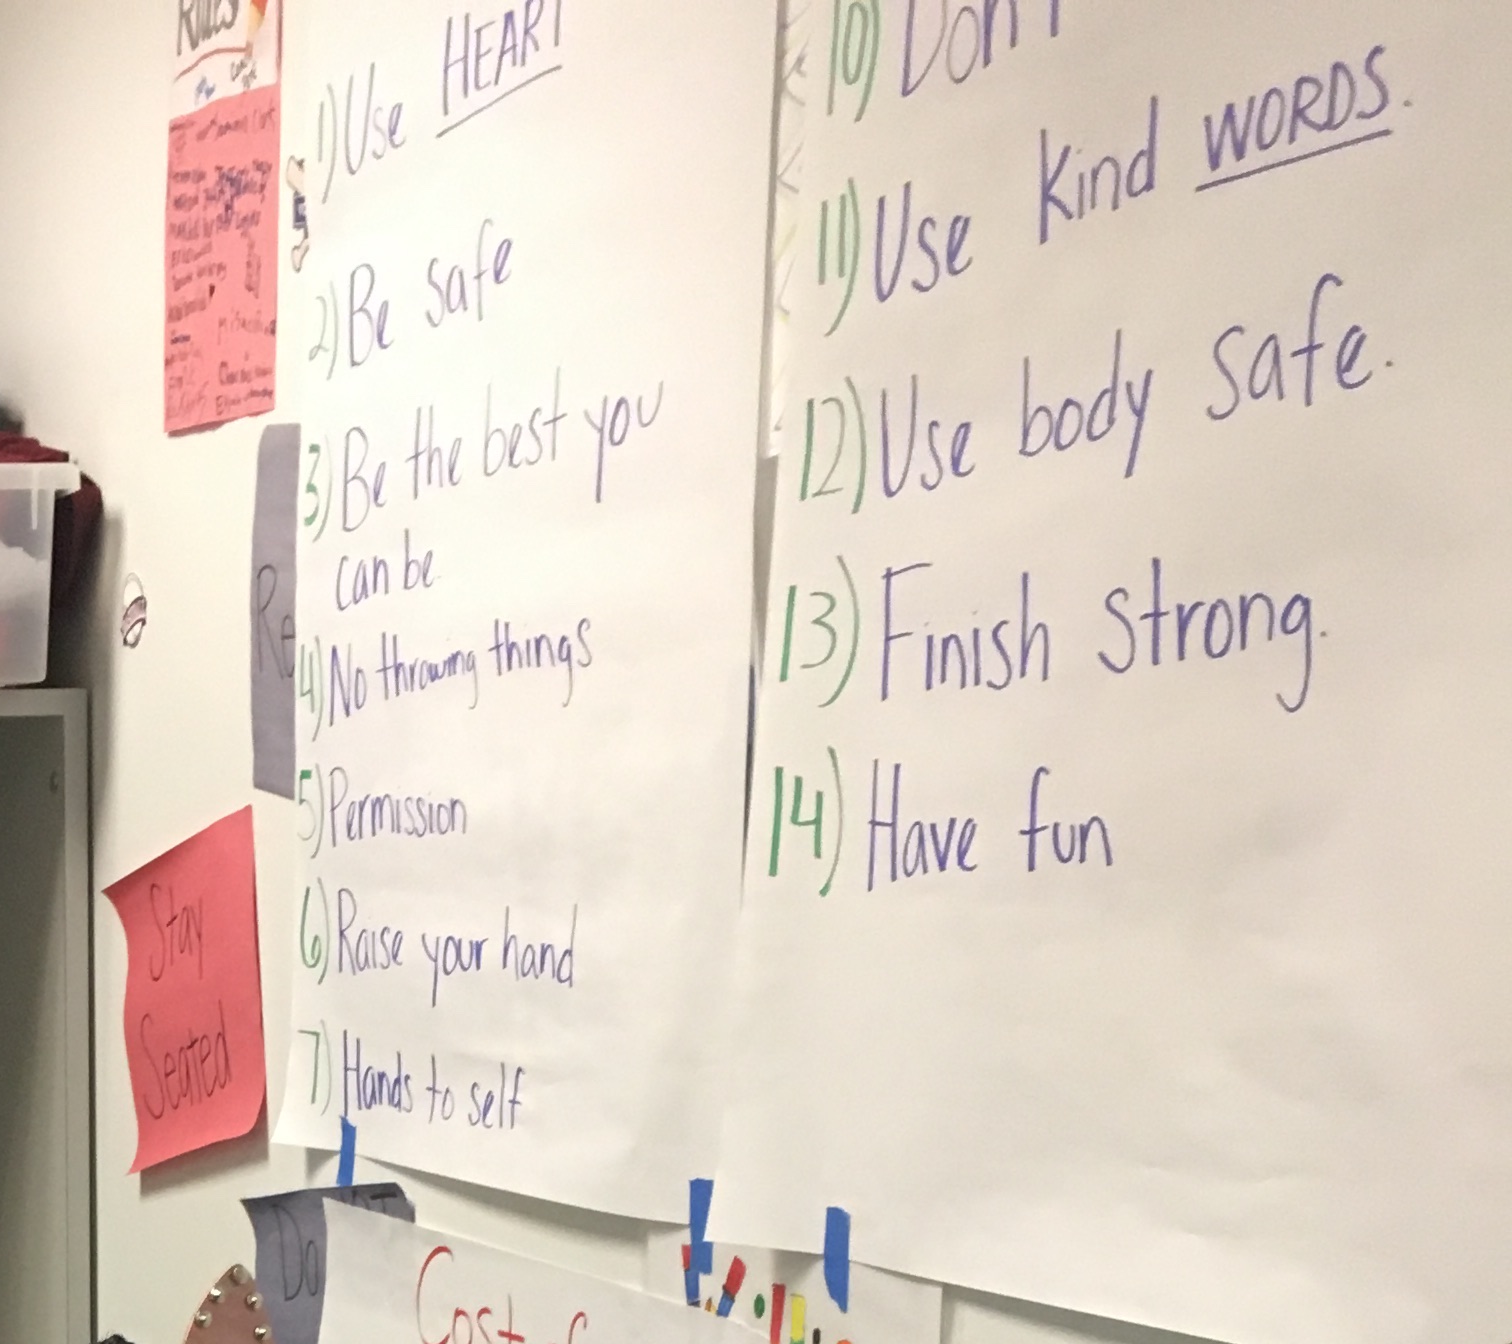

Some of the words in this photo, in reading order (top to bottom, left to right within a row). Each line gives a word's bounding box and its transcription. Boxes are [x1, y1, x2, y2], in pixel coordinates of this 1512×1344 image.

[343, 61, 408, 177] Use
[874, 179, 973, 303] Use
[349, 262, 395, 369] Be
[342, 426, 388, 535] Be
[405, 404, 463, 502] the
[482, 366, 569, 479] best
[583, 381, 665, 504] you
[880, 373, 976, 499] Use
[1018, 328, 1155, 479] body
[336, 552, 391, 612] can
[403, 528, 436, 593] be
[329, 643, 368, 727] No
[488, 615, 593, 708] things
[880, 562, 1052, 702] Finish
[329, 766, 468, 848] Permission
[867, 757, 979, 892] Have
[1018, 765, 1114, 873] fun
[336, 886, 405, 977] Raise
[420, 926, 490, 1008] your
[501, 903, 578, 989] hand
[139, 998, 233, 1121] Seated
[342, 1028, 413, 1118] Hands
[424, 1054, 455, 1124] to
[468, 1062, 527, 1130] self
